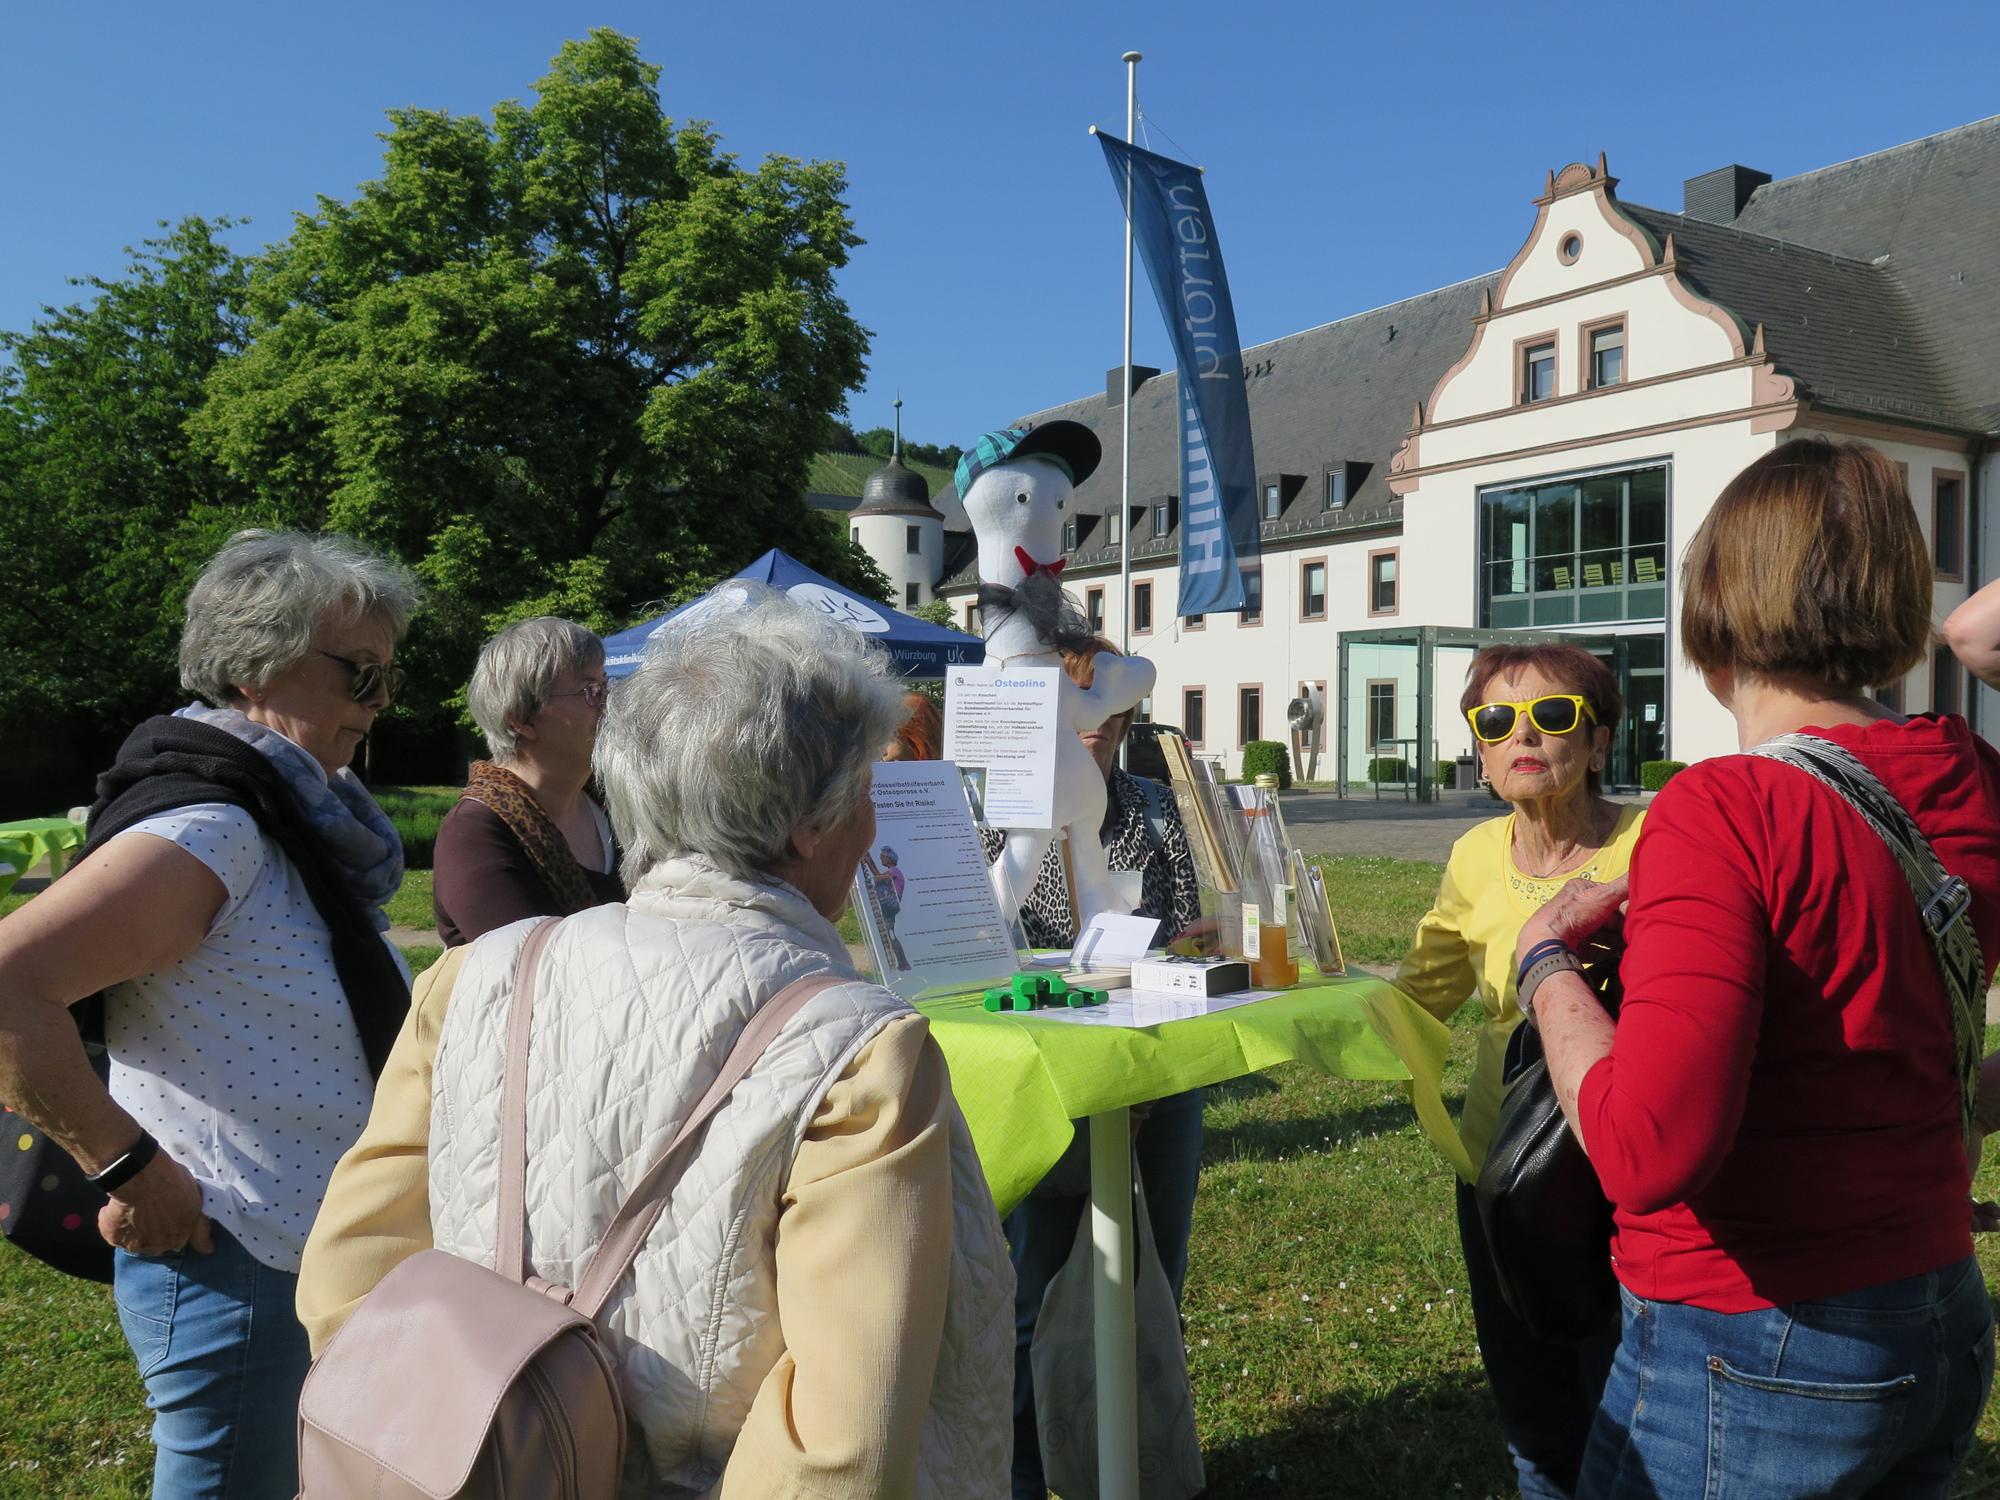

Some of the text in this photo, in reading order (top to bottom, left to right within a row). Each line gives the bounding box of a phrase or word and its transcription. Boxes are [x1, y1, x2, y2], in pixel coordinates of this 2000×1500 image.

[894, 649, 937, 662] Würzburg
[995, 679, 1046, 687] Osteolino
[871, 780, 945, 789] ndesselbsthilfeverband
[877, 788, 917, 796] Osteoporose
